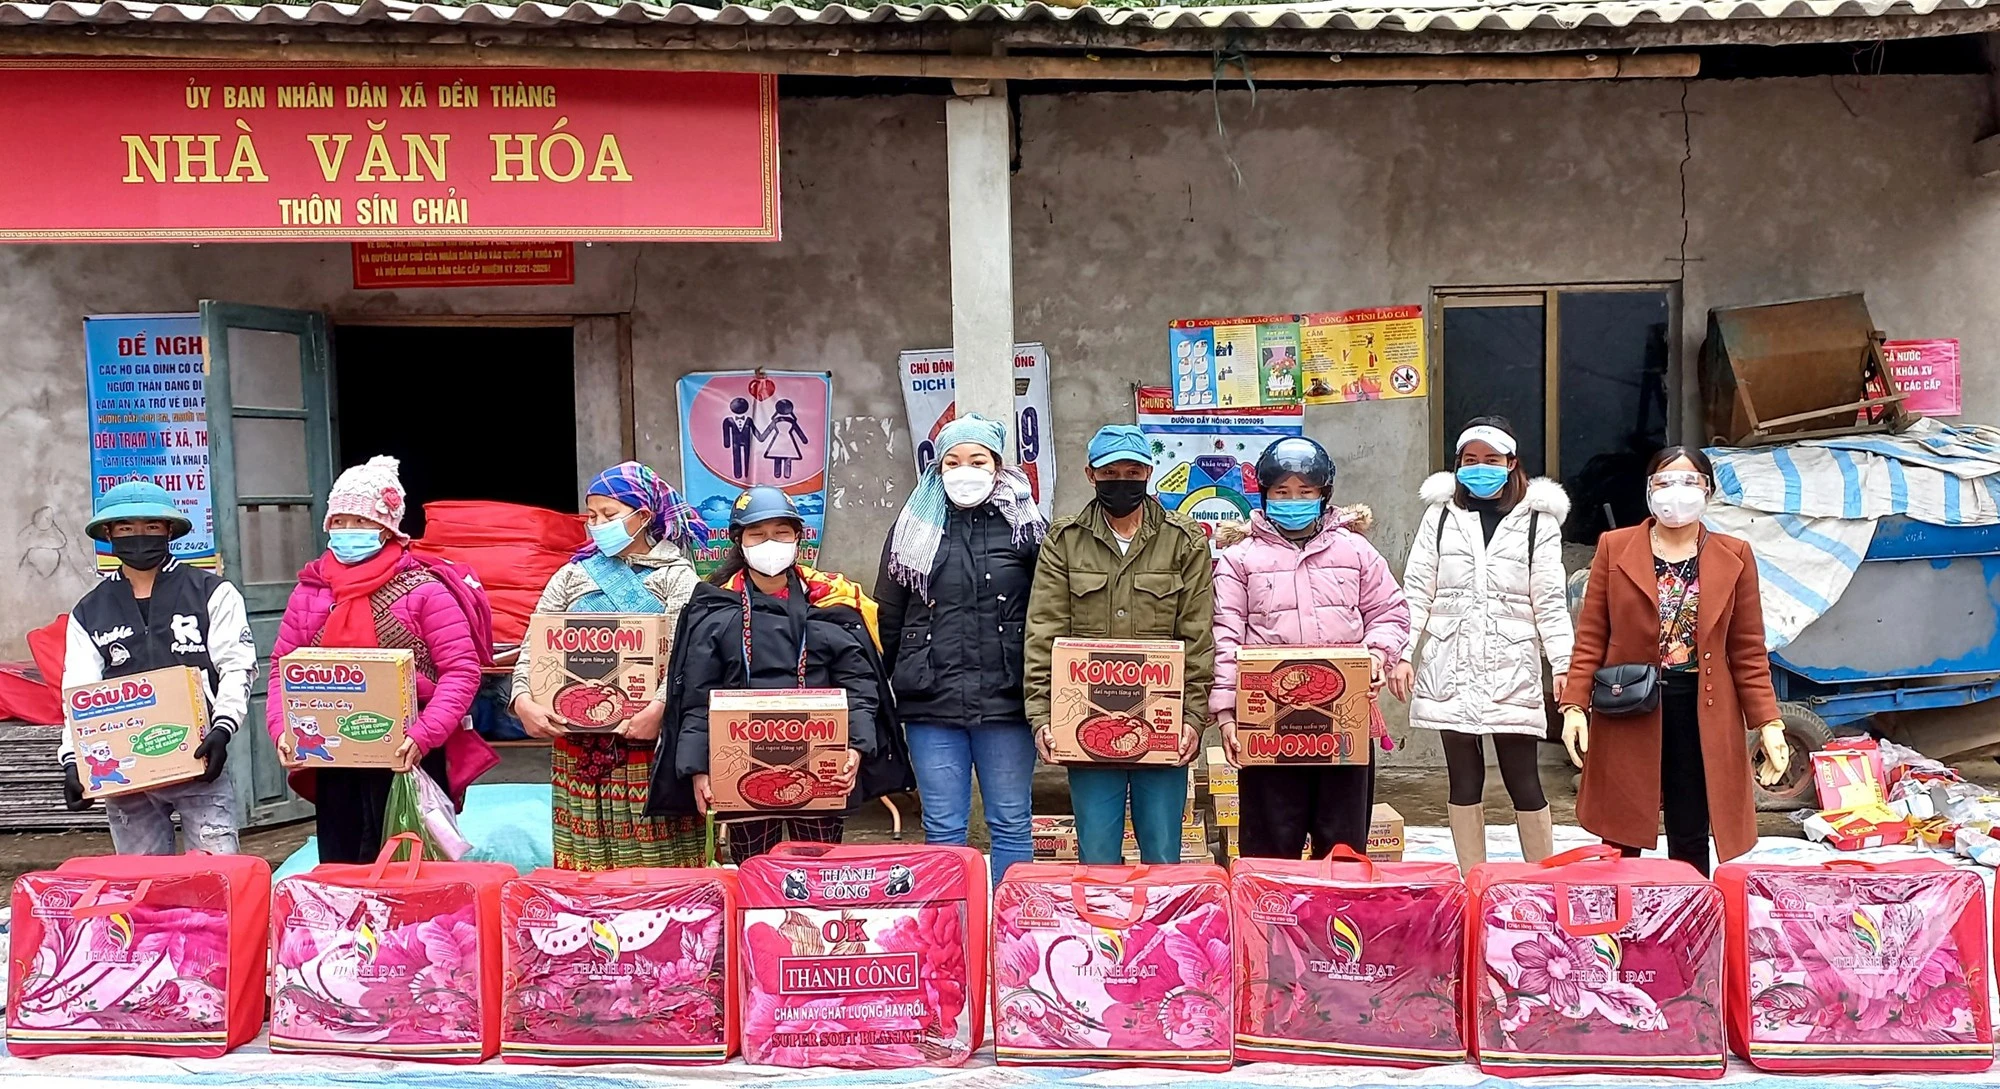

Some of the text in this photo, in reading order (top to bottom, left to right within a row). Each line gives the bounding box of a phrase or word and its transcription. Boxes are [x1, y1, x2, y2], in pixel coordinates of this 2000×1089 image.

[186, 77, 217, 108] ỦY
[224, 86, 266, 108] BAN
[277, 81, 334, 108] NHÂN
[346, 81, 388, 108] DÂN
[400, 80, 428, 108] XÃ
[491, 79, 556, 108] THÀNG
[121, 115, 633, 183] NHÀ VĂN HÓA
[279, 187, 468, 225] THÔN SÍN CHẢI
[1395, 310, 1409, 318] CAI
[156, 336, 202, 355] NGH
[135, 364, 150, 374] GIA
[910, 358, 954, 375] CHỦ ĐỘN
[1015, 353, 1035, 368] ỐNG
[1921, 365, 1933, 376] XV
[912, 378, 946, 394] DỊCH
[1904, 377, 1941, 391] CÁC CẤP
[1140, 397, 1164, 409] CHUNG
[149, 432, 157, 448] Y
[120, 456, 138, 467] TEST
[140, 455, 167, 466] NHANH
[183, 455, 201, 466] KHAI
[154, 466, 206, 491] KHI VỀ
[1192, 510, 1219, 521] THÔNG
[184, 542, 209, 551] 24/24
[170, 614, 202, 644] R
[546, 628, 643, 651] KOKOMI
[286, 664, 364, 683] Gấu Đỏ
[628, 676, 645, 684] Tôm
[1070, 661, 1172, 686] KOKOMI
[72, 687, 119, 710] Gấu
[121, 678, 153, 701] Đỏ
[288, 699, 353, 710] Tôm Chua Cay
[1154, 709, 1172, 717] Tôm
[77, 717, 144, 737] Tôm Chua Cay
[730, 720, 835, 741] KOKOMI
[1249, 733, 1350, 756] KOKOMI
[1032, 839, 1067, 850] OKOMI
[819, 865, 876, 882] THÀNH
[824, 882, 871, 899] CÔNG
[823, 918, 870, 943] OK
[786, 959, 912, 989] THÀNH CÔNG
[1309, 958, 1361, 975] THÀNH
[885, 1003, 905, 1018] HAY
[771, 1029, 929, 1048] SUPER SOFT BLANKET
